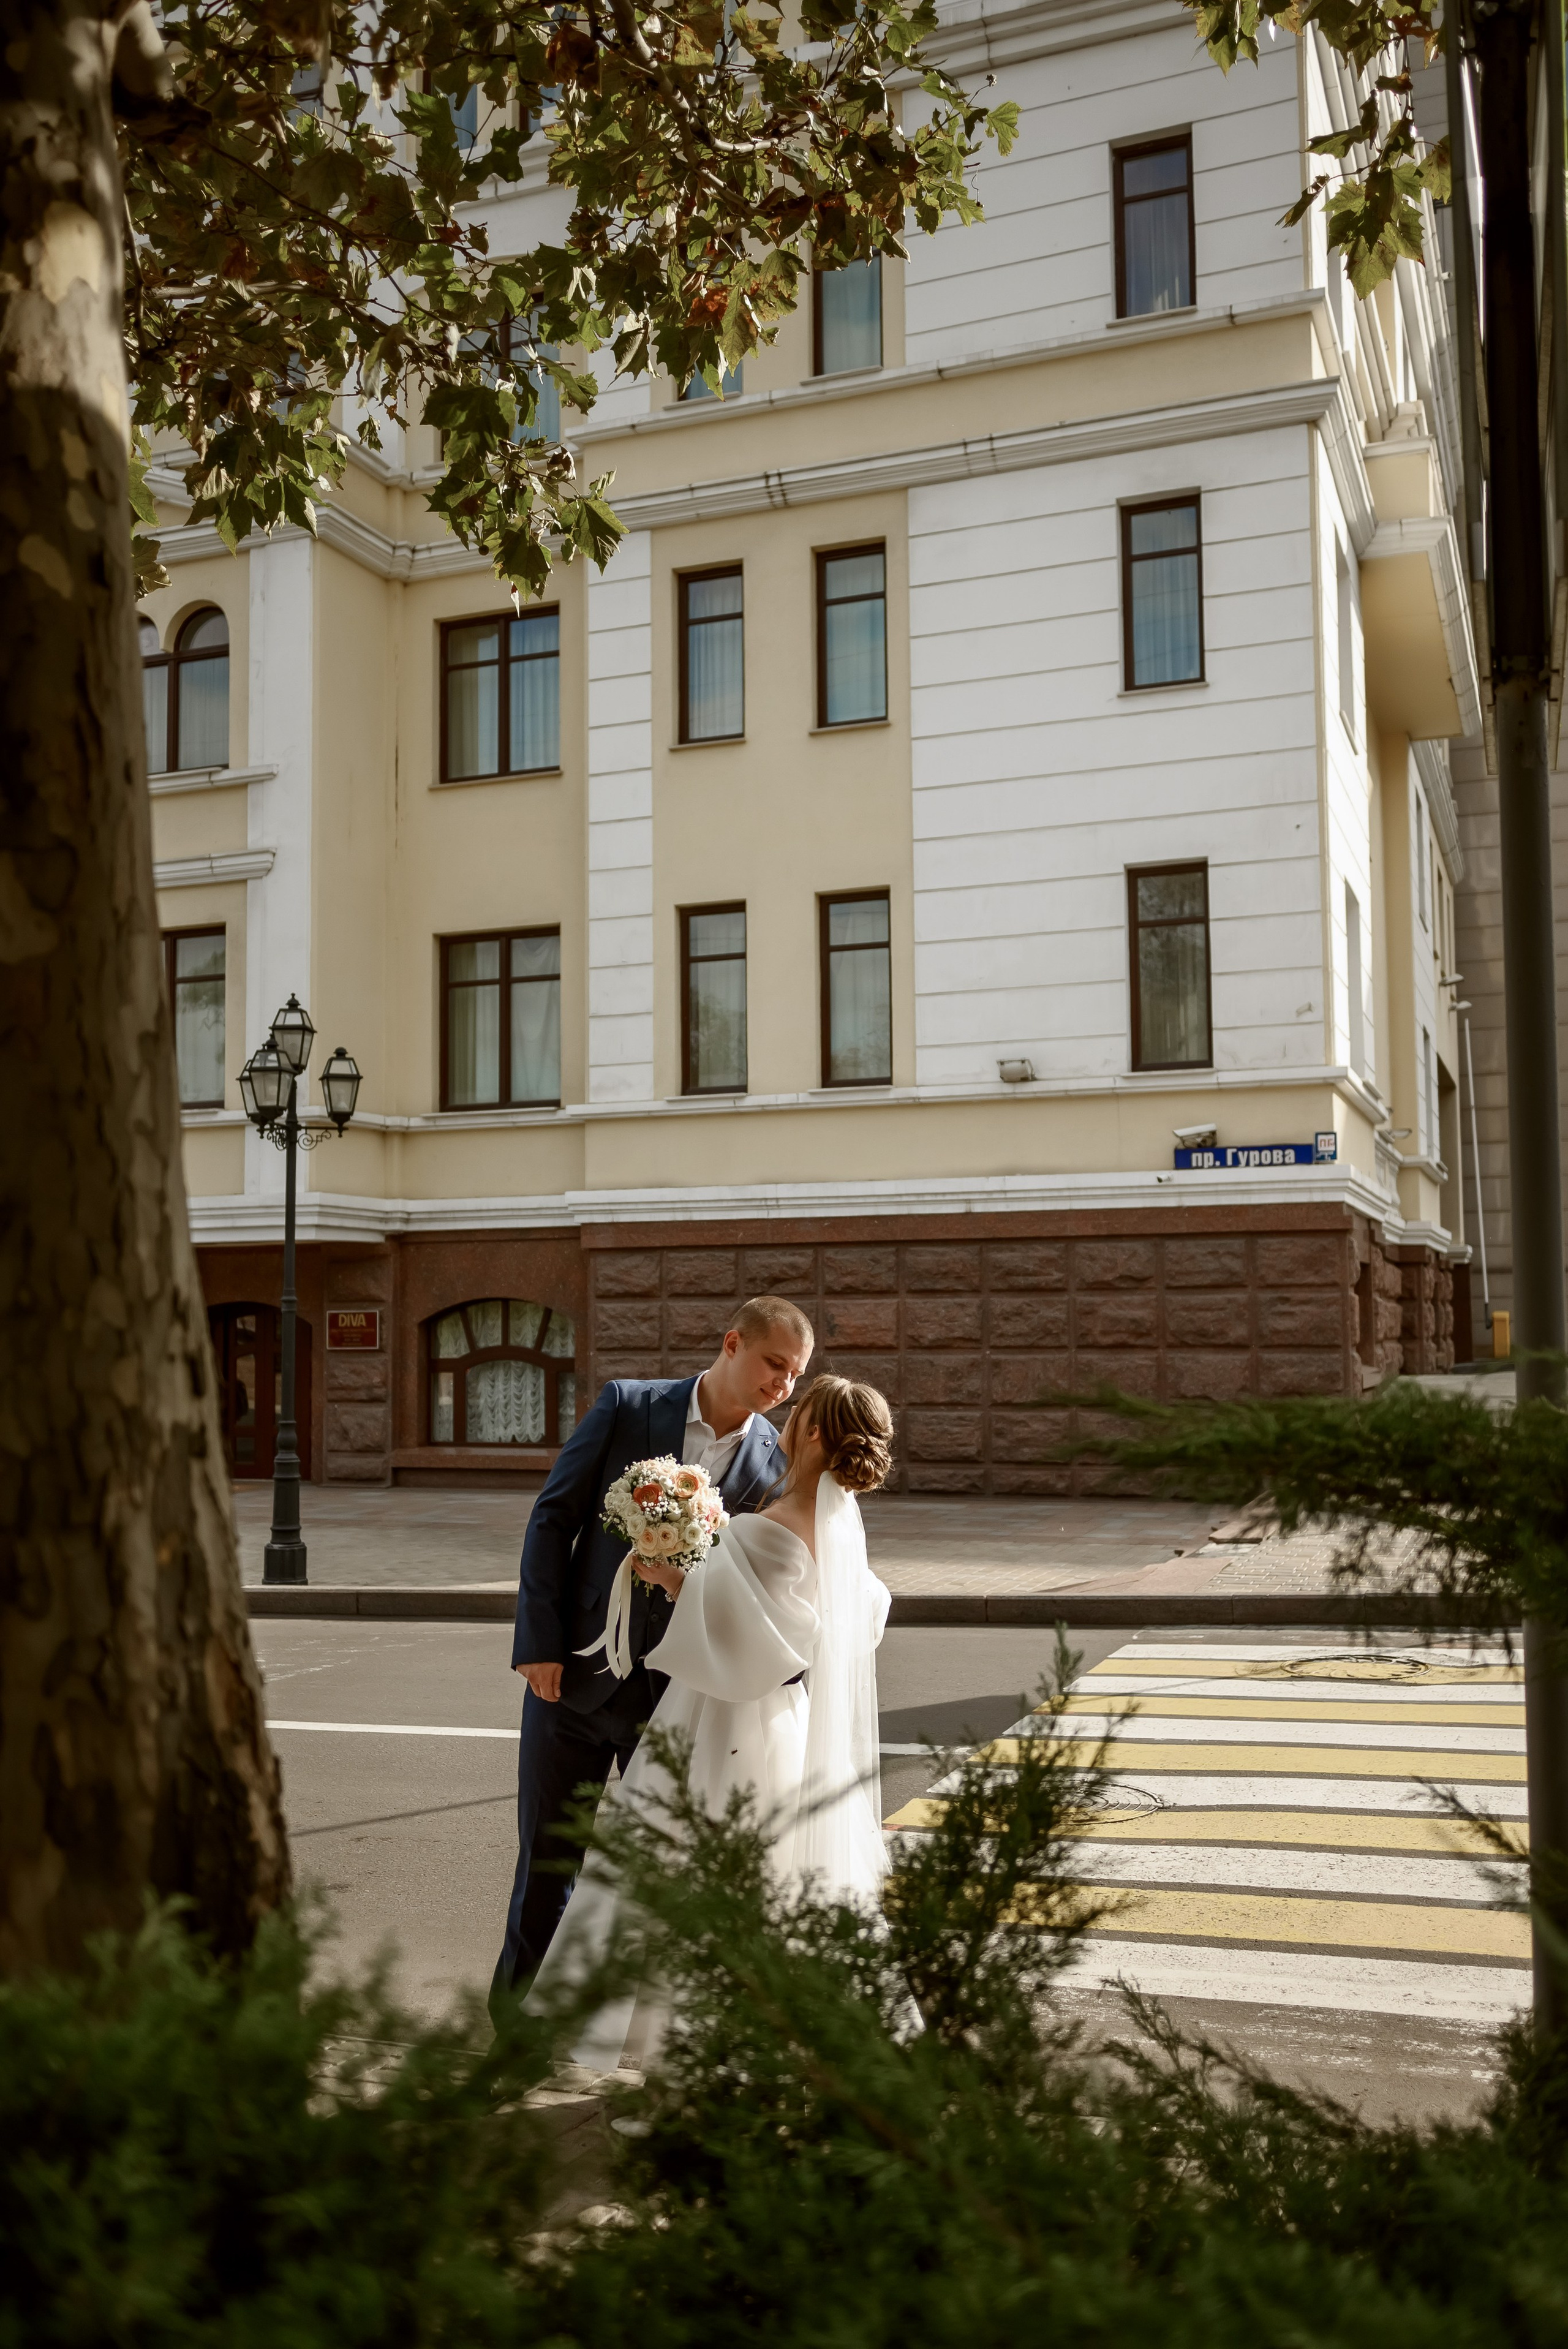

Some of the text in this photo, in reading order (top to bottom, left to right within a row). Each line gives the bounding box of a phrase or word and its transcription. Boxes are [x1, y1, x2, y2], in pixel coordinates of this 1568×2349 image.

[1191, 1148, 1295, 1168] пр. Гурова
[338, 1313, 367, 1327] DIVA
